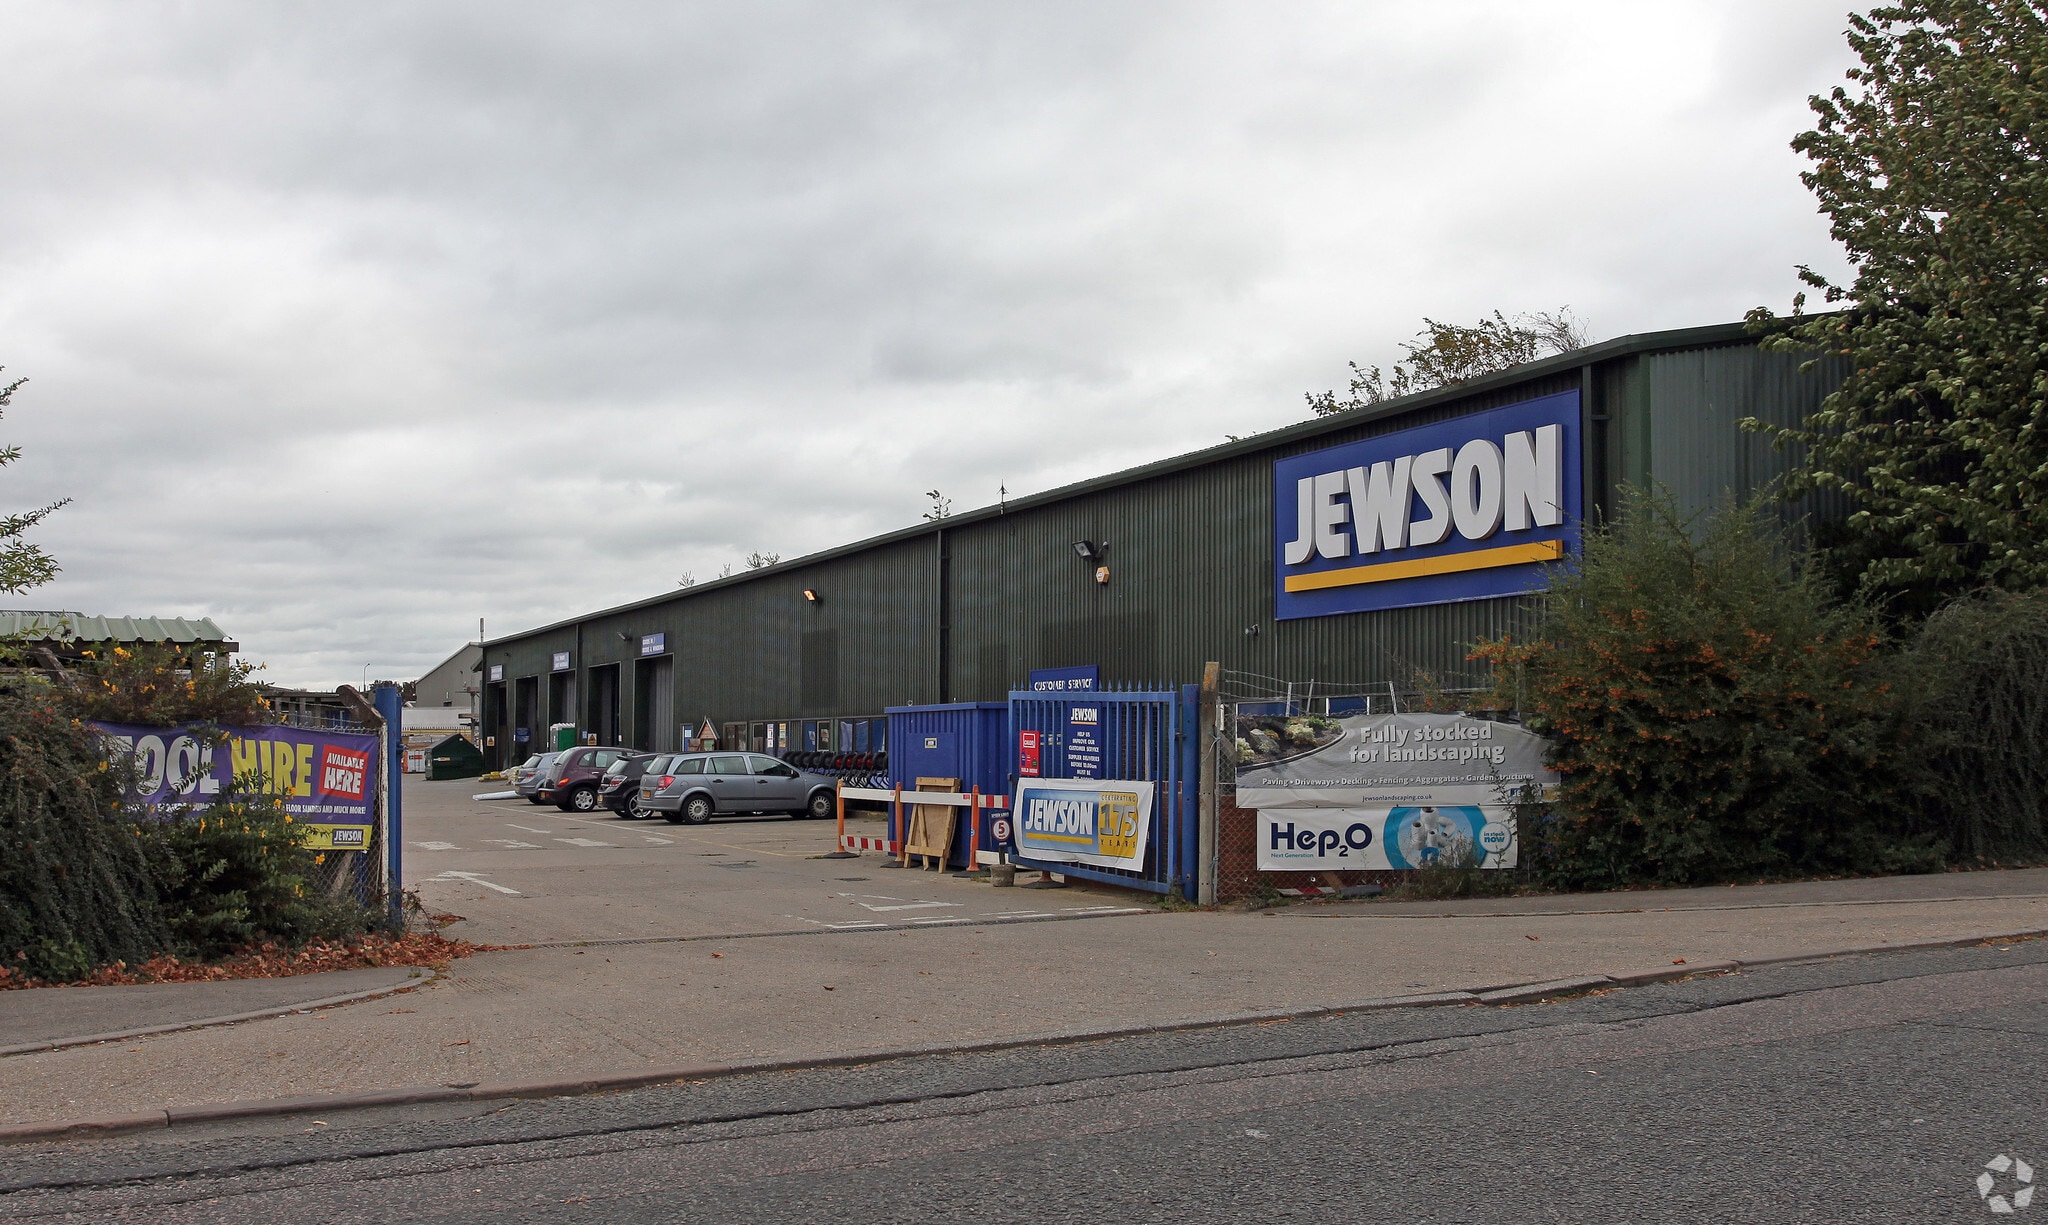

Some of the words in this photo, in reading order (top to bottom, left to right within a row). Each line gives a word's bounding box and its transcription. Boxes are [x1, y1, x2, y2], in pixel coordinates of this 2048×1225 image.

[1285, 424, 1562, 565] JEWSON
[1034, 680, 1065, 691] CUSOMER
[1071, 708, 1097, 721] JEWSON
[1360, 725, 1409, 747] Fully
[1414, 722, 1492, 742] stocked
[1349, 745, 1379, 763] for
[1384, 741, 1505, 764] landscaping
[327, 752, 364, 770] AVAILABLE
[230, 739, 314, 797] HIRE
[324, 766, 362, 794] HERE
[1262, 778, 1289, 787] Paving
[1295, 778, 1335, 787] Driveways
[1341, 777, 1372, 787] Decking
[1379, 776, 1409, 786] Fencing
[1416, 775, 1459, 785] Aggregates
[1466, 774, 1494, 782] Garden
[1101, 795, 1136, 803] CELEBRATING
[1362, 794, 1433, 802] jewsonlandscaping.co.uk
[1513, 788, 1542, 798] JEON
[286, 803, 302, 813] FLOOR
[322, 805, 333, 813] AND
[334, 805, 349, 814] MUCH
[1025, 799, 1094, 835] JEWSON
[1100, 803, 1137, 838] 175
[998, 822, 1005, 835] 5
[334, 830, 362, 841] JEWSON
[1271, 822, 1373, 858] Hep2O
[1101, 839, 1136, 848] YEARS
